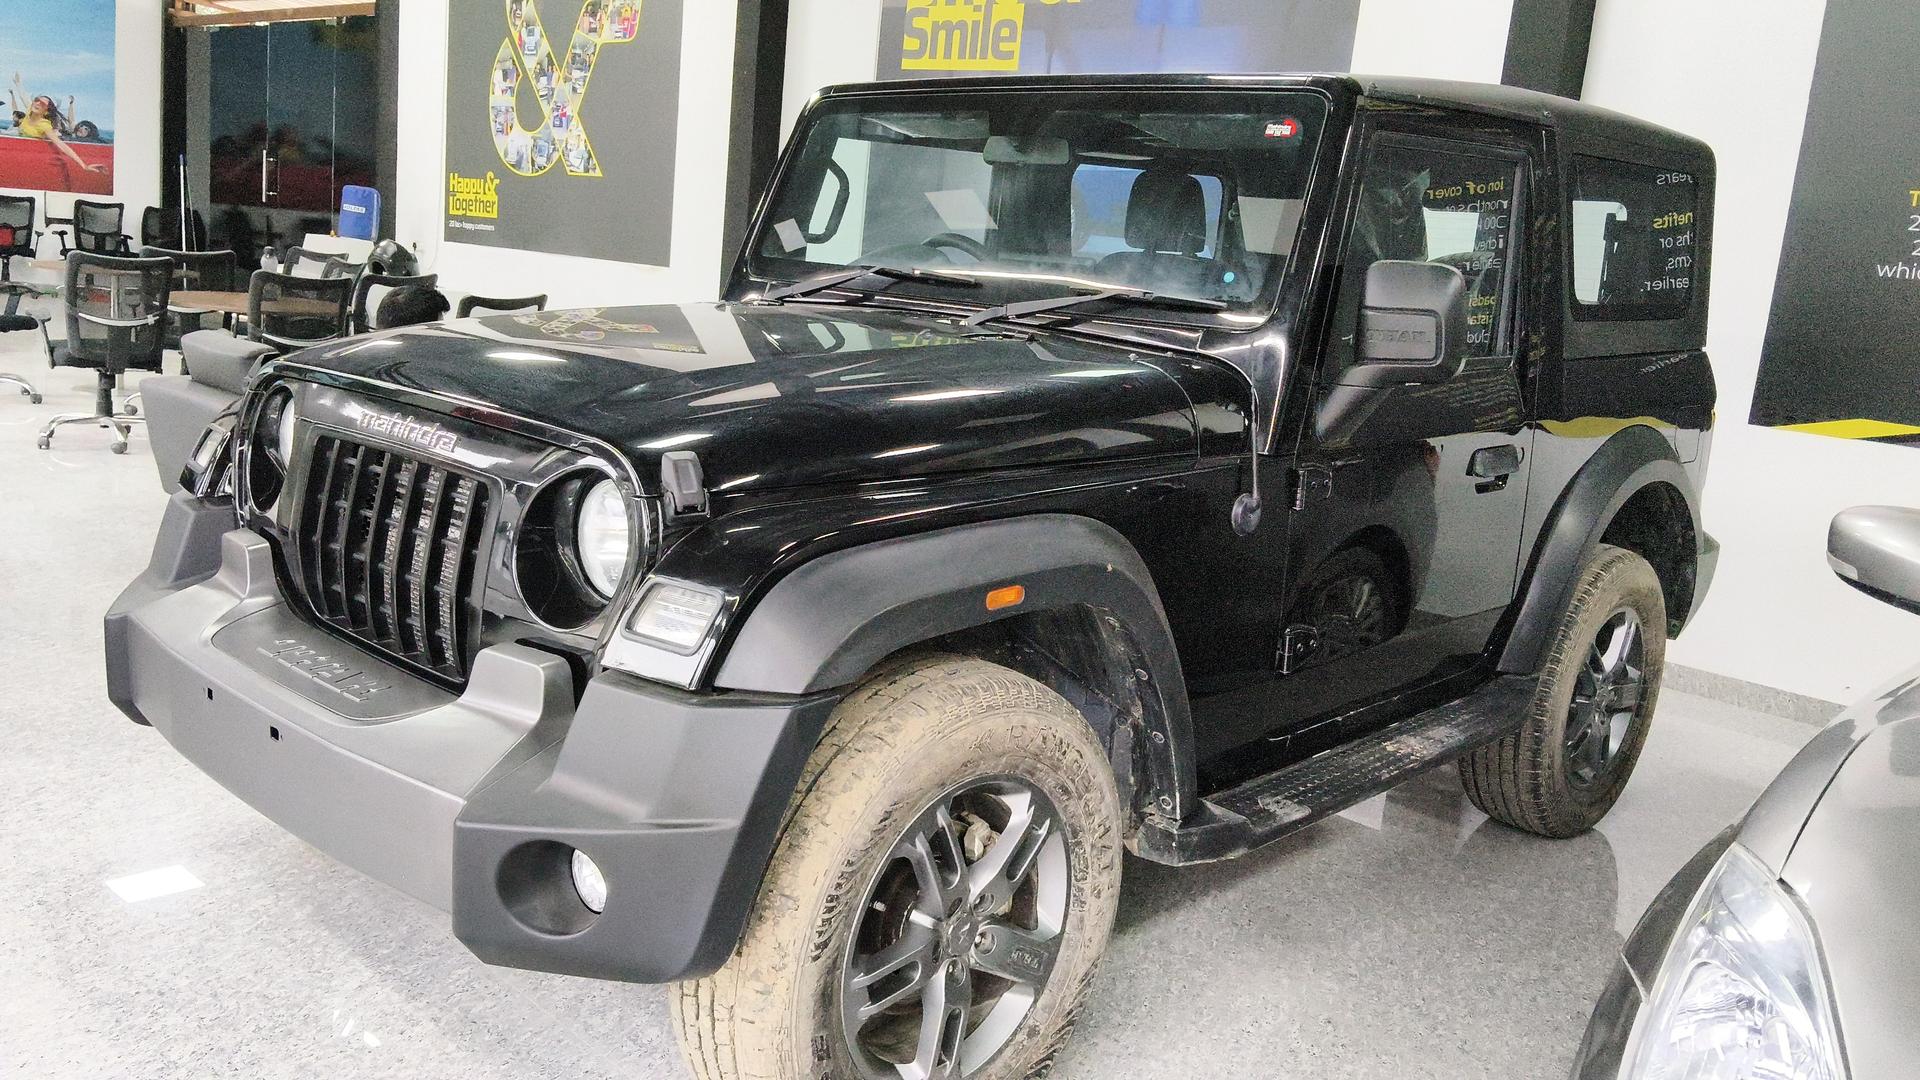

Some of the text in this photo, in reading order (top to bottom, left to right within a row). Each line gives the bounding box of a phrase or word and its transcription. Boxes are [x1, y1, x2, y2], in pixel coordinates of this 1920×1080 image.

[903, 2, 1017, 60] Smile
[449, 193, 496, 215] Together
[1877, 261, 1920, 280] whi
[357, 408, 459, 453] mahindra
